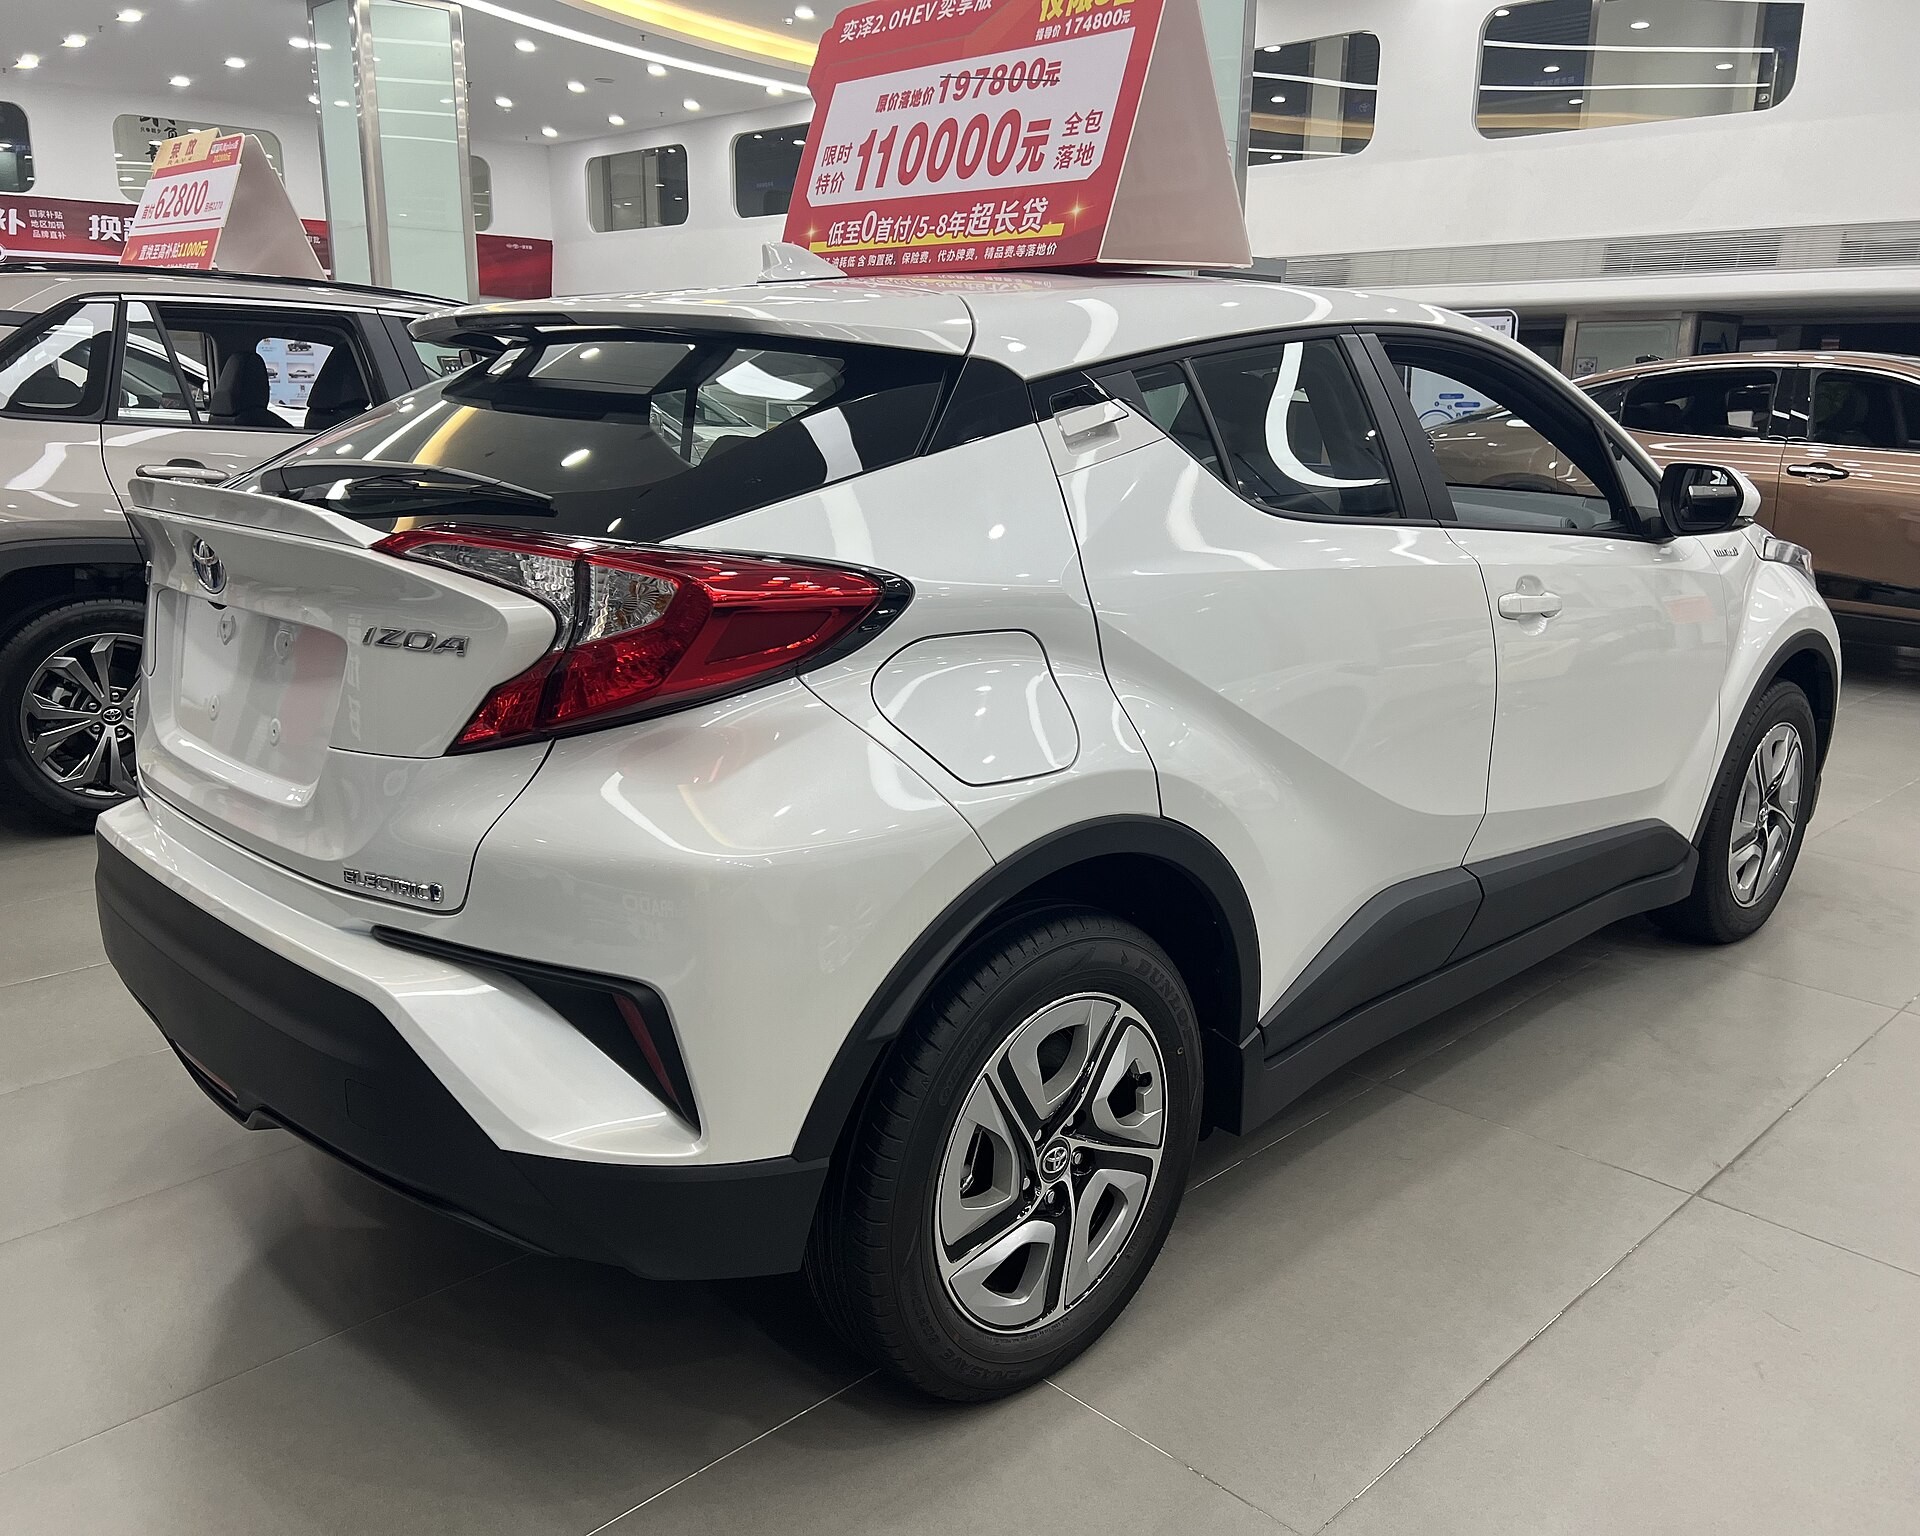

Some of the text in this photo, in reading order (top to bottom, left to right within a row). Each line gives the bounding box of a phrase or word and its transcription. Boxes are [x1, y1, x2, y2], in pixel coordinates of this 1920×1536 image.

[1065, 9, 1131, 36] 174800元
[875, 57, 1062, 113] 原价落地价 197800元
[1062, 109, 1103, 137] 全包
[821, 142, 853, 167] 限时
[855, 109, 1052, 191] 110000元
[1053, 142, 1095, 170] 落地
[815, 172, 846, 196] 特价
[154, 180, 209, 219] 62800
[28, 208, 63, 220] 国家补贴
[30, 219, 65, 230] 地区加码
[32, 229, 67, 240] 品牌直补
[362, 626, 469, 657] IZOA
